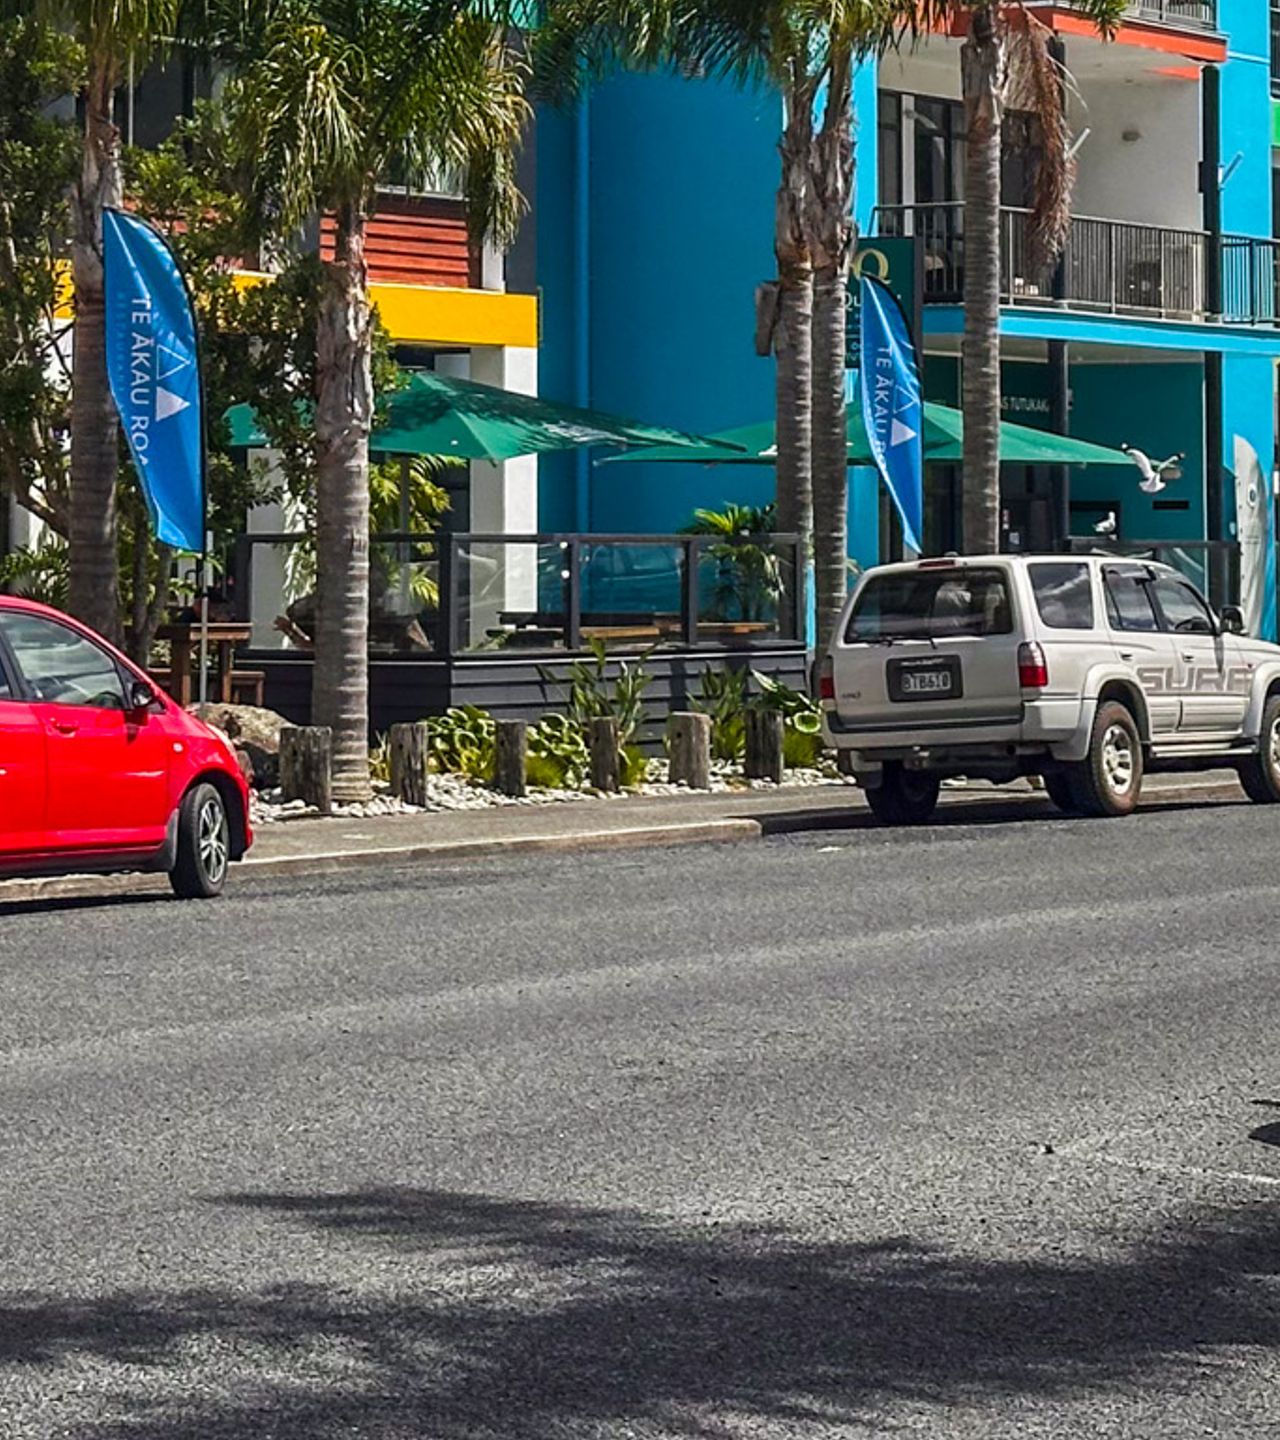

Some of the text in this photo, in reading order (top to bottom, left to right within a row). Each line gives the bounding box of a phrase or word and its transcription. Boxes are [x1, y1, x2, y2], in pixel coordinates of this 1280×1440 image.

[131, 297, 151, 324] TE
[130, 332, 155, 405] ĀKAU
[876, 343, 894, 369] TE
[1136, 666, 1254, 692] SURF
